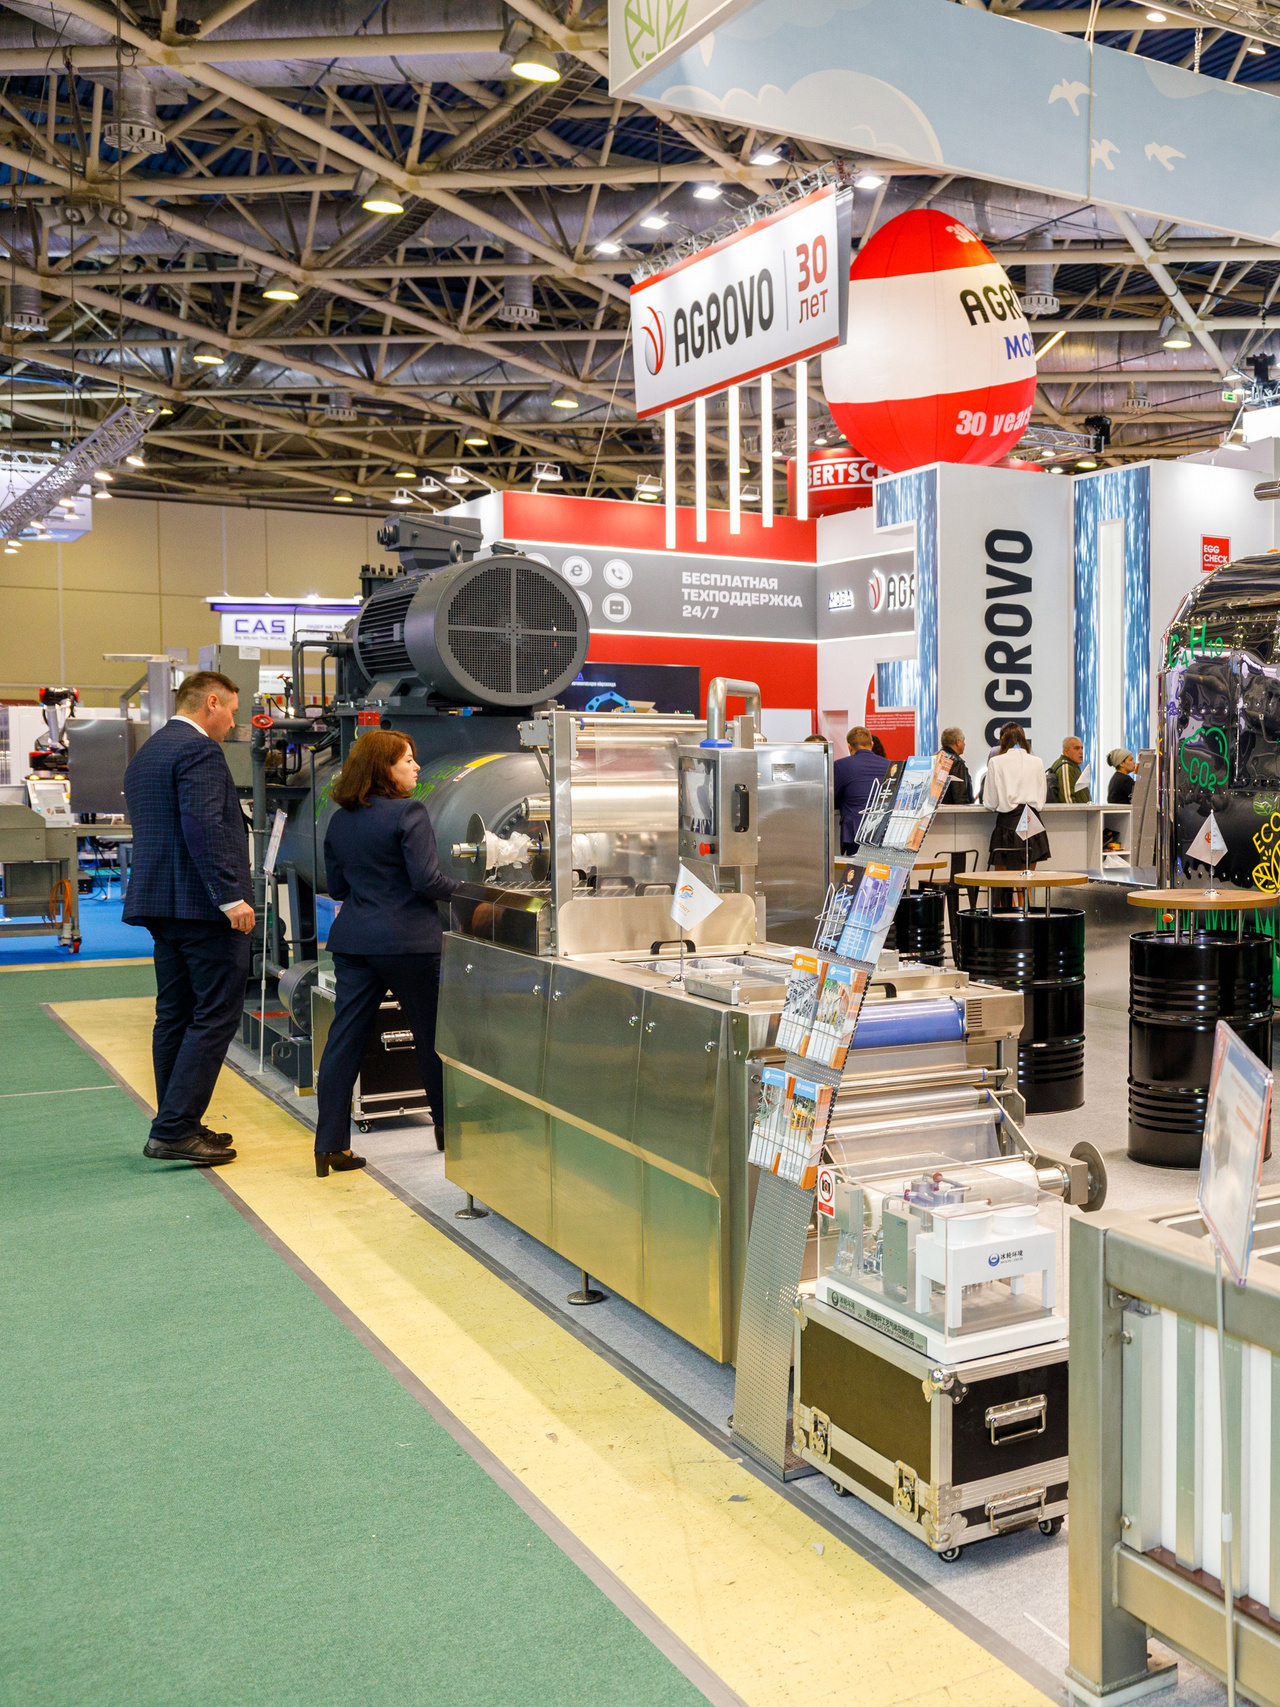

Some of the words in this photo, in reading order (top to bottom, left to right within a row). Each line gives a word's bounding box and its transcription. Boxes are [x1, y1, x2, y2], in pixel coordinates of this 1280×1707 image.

[796, 235, 828, 293] 30
[799, 289, 829, 324] лет
[959, 283, 1022, 326] AGR
[674, 268, 774, 367] AGROVO
[955, 410, 987, 436] 30
[990, 405, 1033, 437] years
[1203, 544, 1220, 554] EGG
[1203, 553, 1228, 564] CHECK
[682, 572, 778, 590] БЕСПЛАТНАЯ
[682, 588, 803, 608] ТЕХПОДДЕРЖКА
[682, 604, 719, 619] 24/7
[235, 619, 285, 633] CAS
